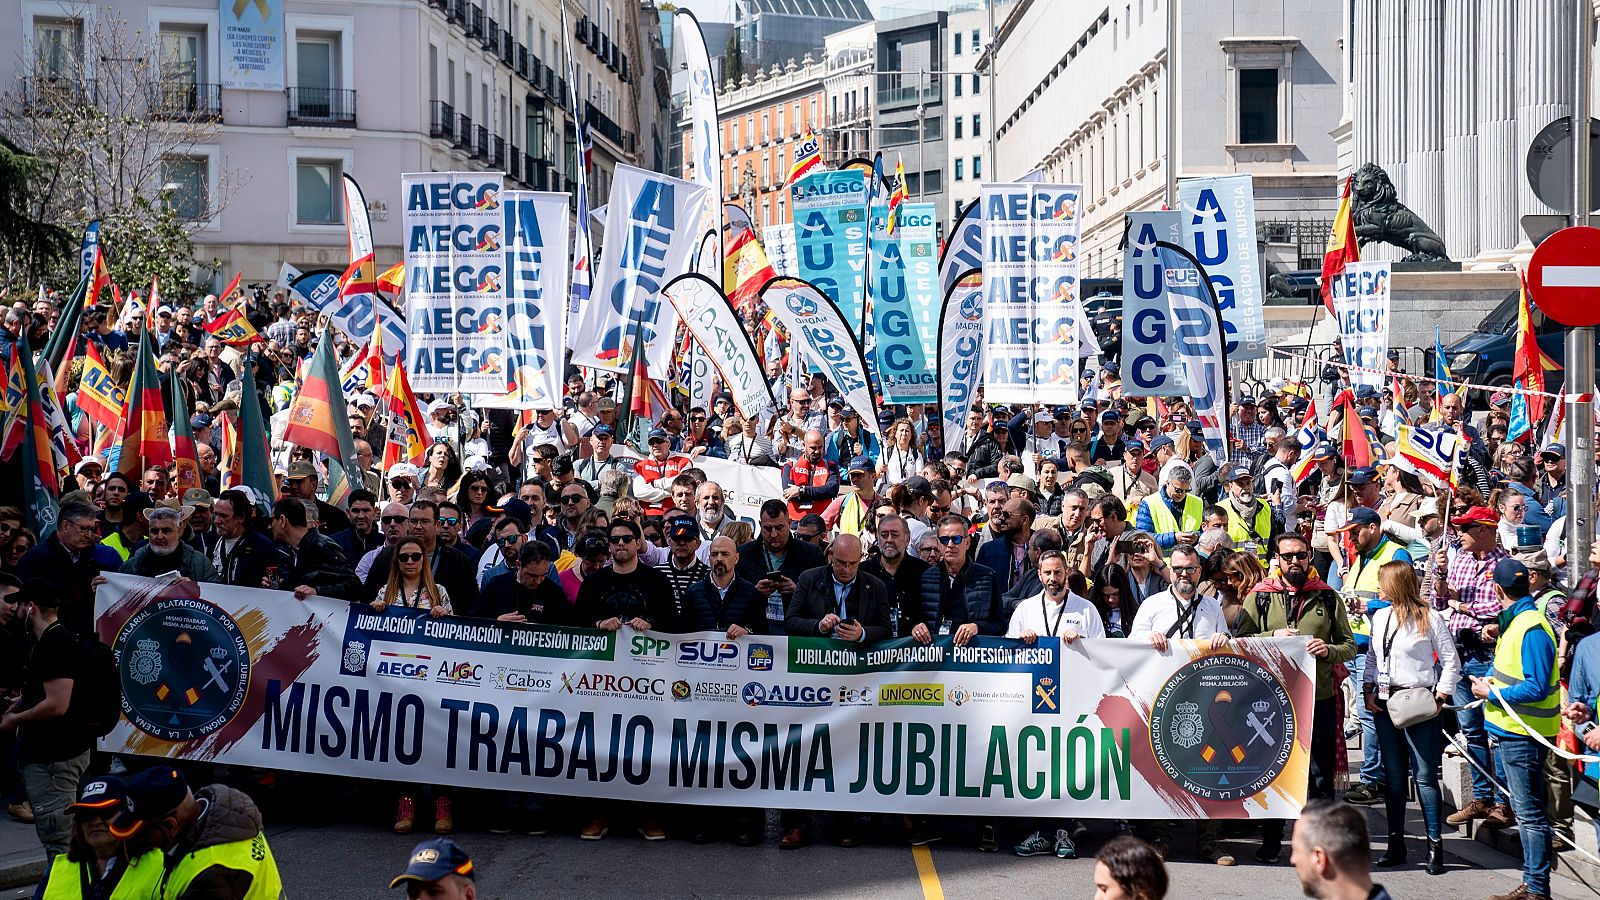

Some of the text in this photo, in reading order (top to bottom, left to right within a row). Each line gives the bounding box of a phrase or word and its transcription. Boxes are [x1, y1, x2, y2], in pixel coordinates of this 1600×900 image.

[236, 34, 256, 42] EUROPEO
[233, 56, 270, 64] PROFESIONALES
[239, 63, 265, 71] SANITARIOS
[408, 182, 500, 211] AEGC
[807, 180, 863, 197] AUGC
[986, 193, 1077, 221] AEGC
[1234, 185, 1248, 240] MURCIA
[893, 215, 932, 227] UGC
[409, 224, 501, 253] AEGC
[987, 235, 1076, 262] AEGC
[802, 211, 840, 303] AUG
[1238, 242, 1249, 260] DE
[411, 265, 502, 294] AEGC
[988, 276, 1076, 303] AEGC
[879, 243, 914, 370] AUGC
[916, 262, 936, 370] SEVILLA
[1130, 223, 1167, 389] AUGC
[412, 306, 502, 335] AEGC
[956, 322, 983, 331] MADRI
[988, 317, 1074, 344] AEGC
[414, 347, 503, 375] AEGC
[989, 358, 1074, 384] AEGC
[82, 366, 125, 407] AEG
[897, 374, 937, 384] AUG
[944, 336, 978, 428] AUGC
[645, 464, 678, 472] SEGUDAD
[794, 467, 828, 475] SEGDAD
[158, 600, 214, 614] PLATAFORMA
[120, 610, 151, 643] SALARIAL
[183, 617, 206, 625] TRABAJO
[219, 614, 235, 631] POR
[354, 613, 608, 652] JUBILACIÓN EQUIPARACIÓN PROFESIÓN RIESGO
[235, 636, 246, 656] UNA
[630, 636, 670, 656] SPP
[679, 642, 738, 663] SUP
[795, 643, 1052, 666] JUBILACIÓN EQUIPARACIÓN PROFESIÓN RIESGO
[377, 661, 428, 678] AEGC
[437, 661, 484, 680] AIGC
[1193, 656, 1249, 671] PLATAFORMA
[507, 673, 551, 688] Cabos
[576, 673, 665, 695] APROGC
[1256, 668, 1273, 683] POR
[229, 662, 248, 712] JUBILACIÓN
[768, 685, 832, 702] AUGC
[1157, 673, 1186, 708] SALARIAL
[1275, 686, 1287, 706] UNA
[136, 716, 160, 735] PLENA
[200, 716, 226, 734] DIGNA
[262, 679, 1131, 800] MISMO TRABAJO MISMA JUBILACIÓN
[1151, 716, 1179, 778] EQUIPARACIÓN
[1277, 713, 1293, 766] JUBILACIÓN
[1183, 780, 1211, 798] PLENA
[1251, 770, 1276, 790] DIGNA
